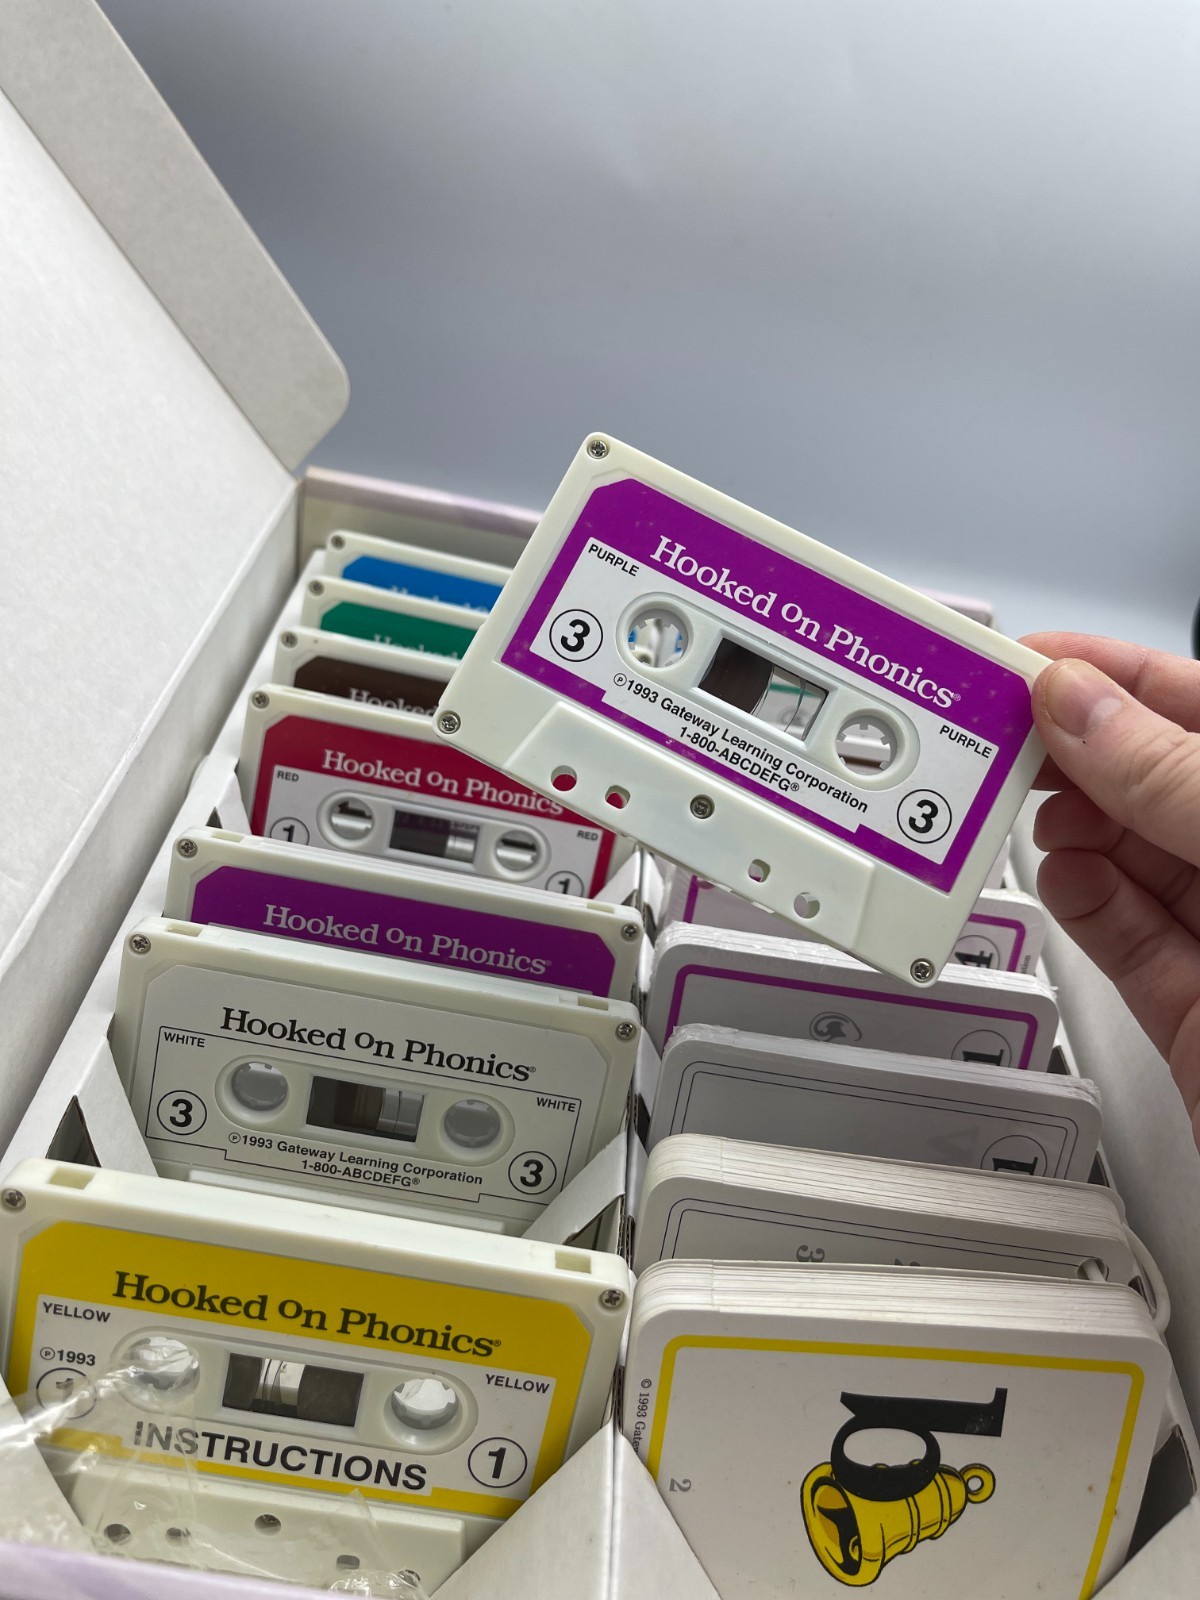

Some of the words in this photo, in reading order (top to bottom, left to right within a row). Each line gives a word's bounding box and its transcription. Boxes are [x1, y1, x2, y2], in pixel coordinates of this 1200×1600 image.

[588, 544, 640, 577] PURPLE
[650, 535, 777, 618] Hooked
[560, 619, 591, 652] 3
[660, 697, 720, 737] Gateway
[721, 728, 782, 770] Learning
[786, 763, 868, 813] Corporation
[940, 725, 992, 759] PURPLE
[277, 770, 299, 782] RED
[321, 749, 420, 787] Hooked
[464, 778, 563, 816] Phonics
[908, 799, 939, 834] 3
[577, 830, 598, 841] RED
[263, 904, 379, 945] Hooked
[164, 1032, 206, 1047] WHITE
[220, 1007, 346, 1050] Hooked
[169, 1099, 193, 1128] 3
[536, 1097, 576, 1112] WHITE
[277, 1141, 336, 1162] Gateway
[339, 1152, 399, 1173] Learning
[402, 1162, 483, 1185] Corporation
[520, 1159, 544, 1187] 3
[42, 1302, 111, 1323] YELLOW
[112, 1271, 268, 1321] Hooked
[485, 1374, 550, 1394] YELLOW
[637, 1392, 650, 1418] 1993
[133, 1421, 427, 1491] INSTRUCTIONS
[488, 1447, 506, 1479] 1
[669, 1478, 692, 1492] 2
